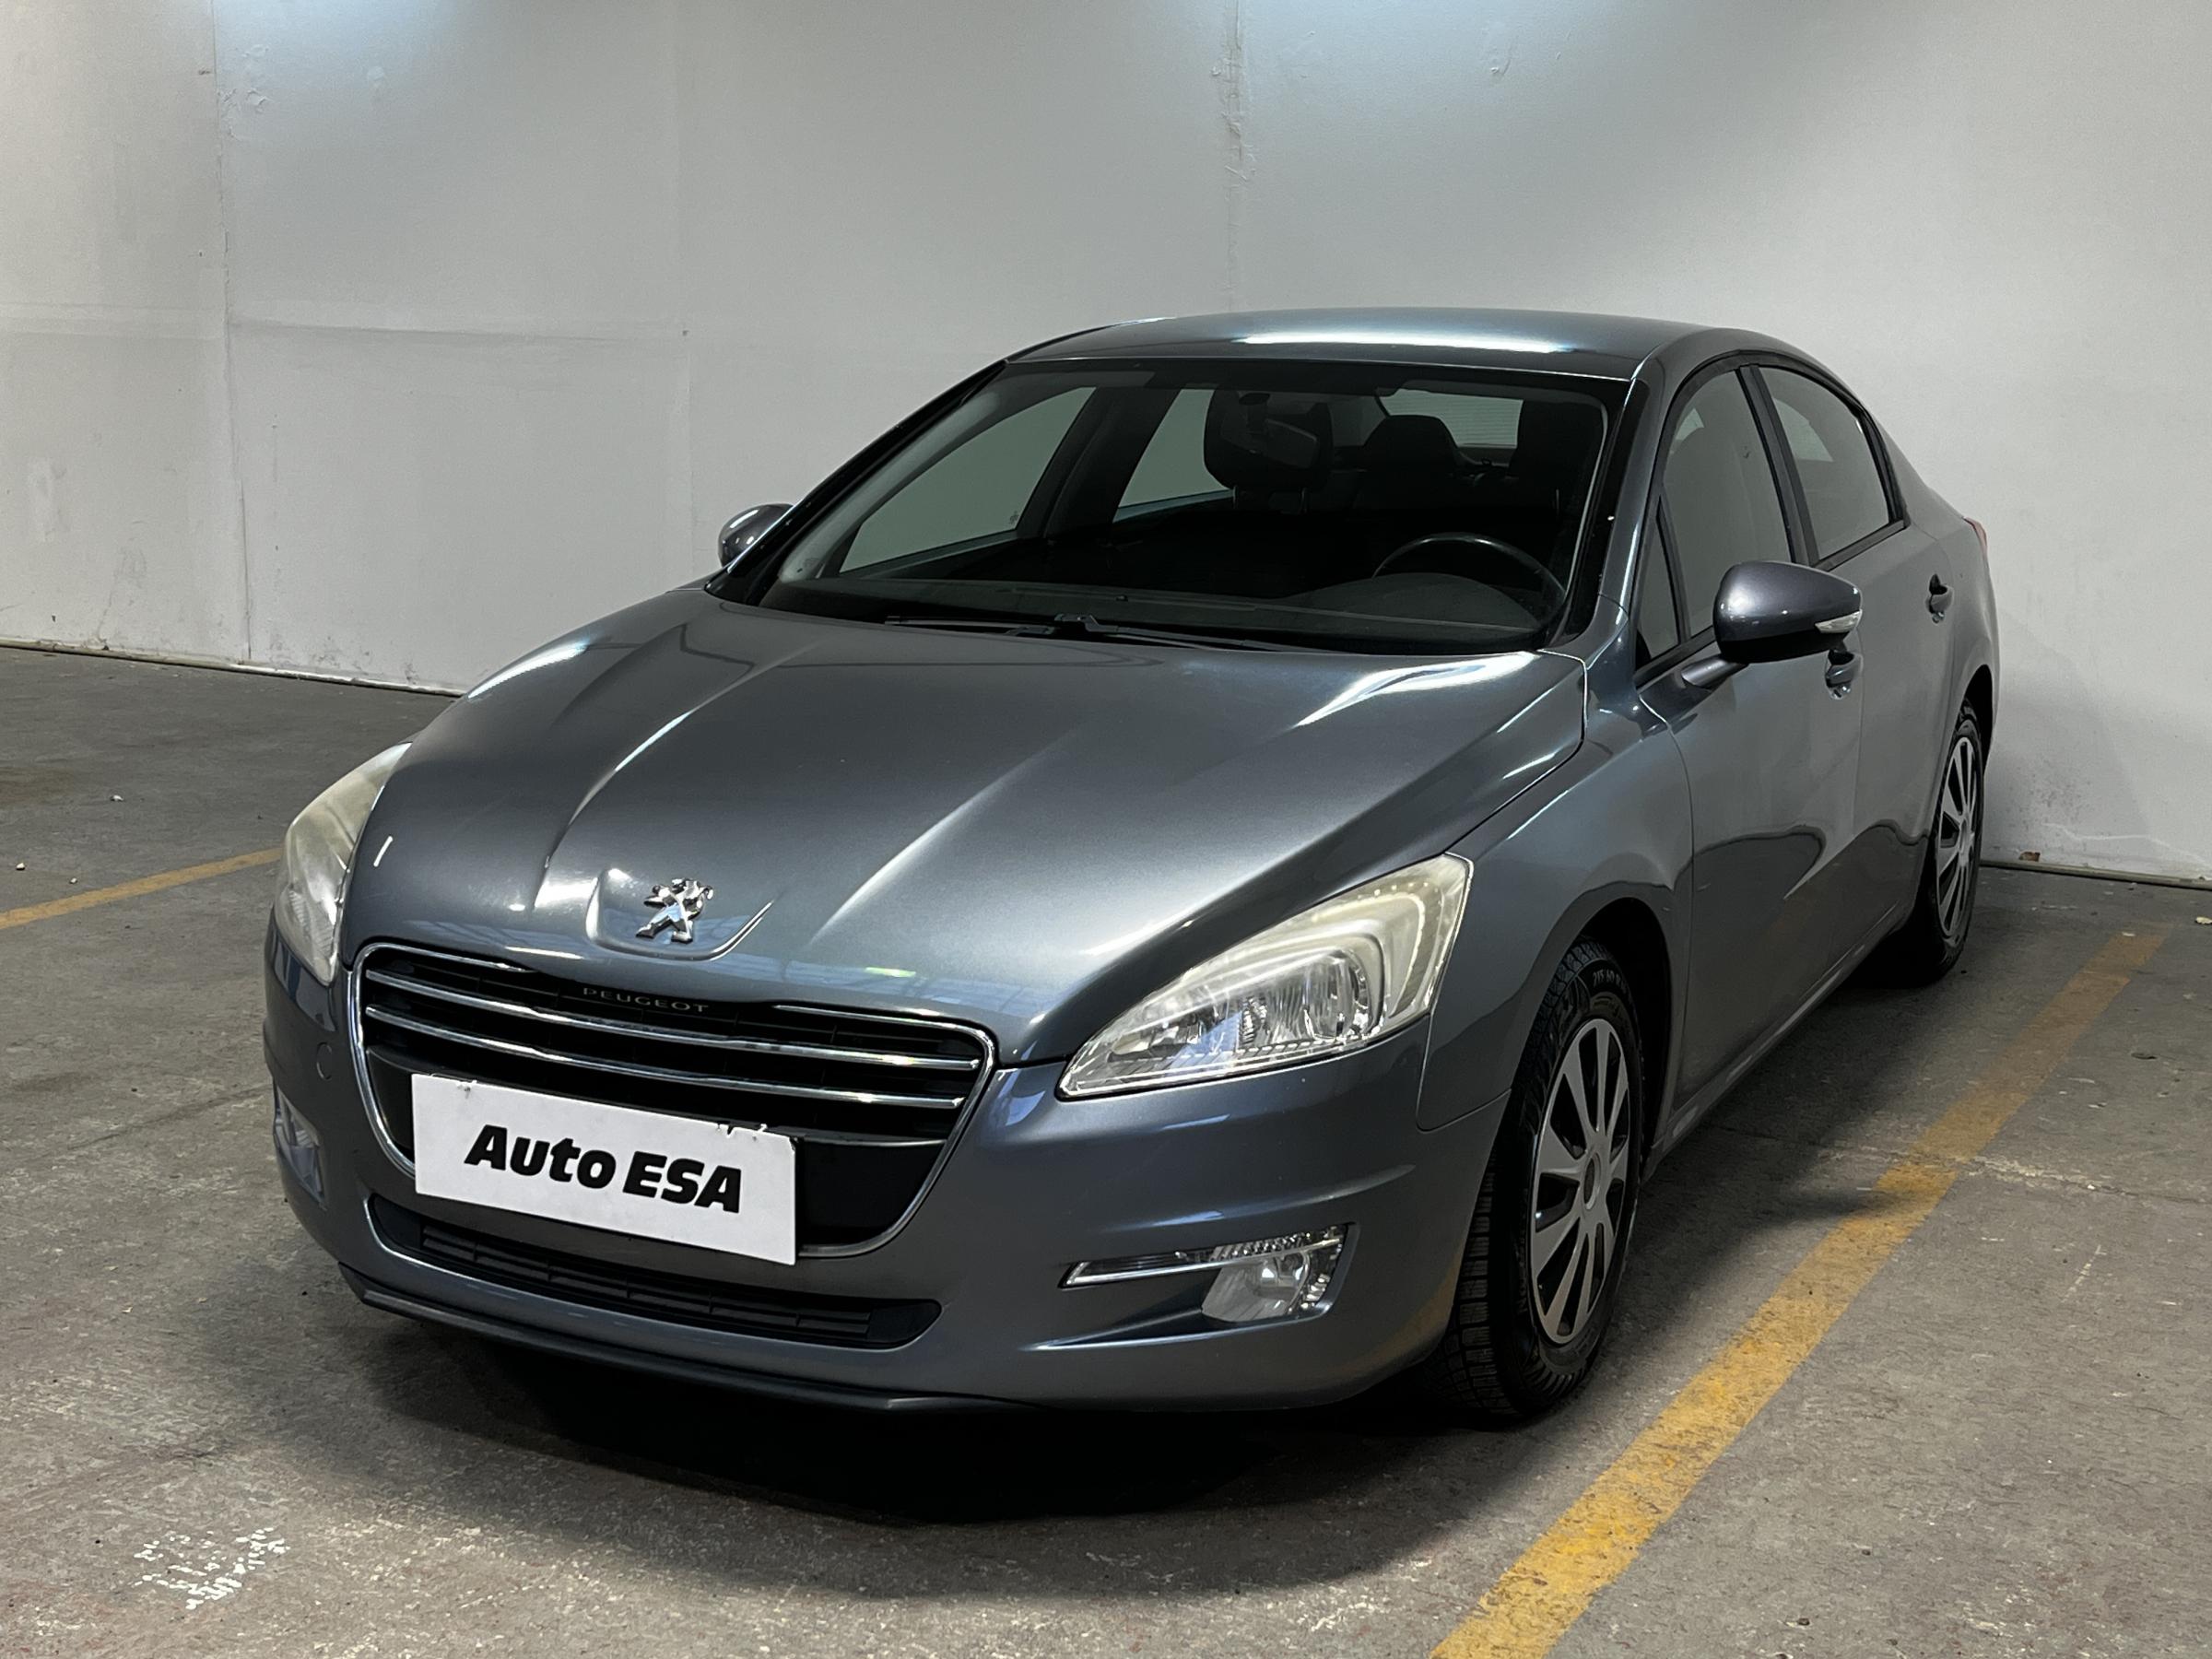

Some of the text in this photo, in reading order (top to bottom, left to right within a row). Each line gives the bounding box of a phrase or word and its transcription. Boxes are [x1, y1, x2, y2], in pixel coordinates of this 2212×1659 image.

[583, 987, 709, 1012] PEUGEOT
[464, 1124, 742, 1214] Auto ESA
